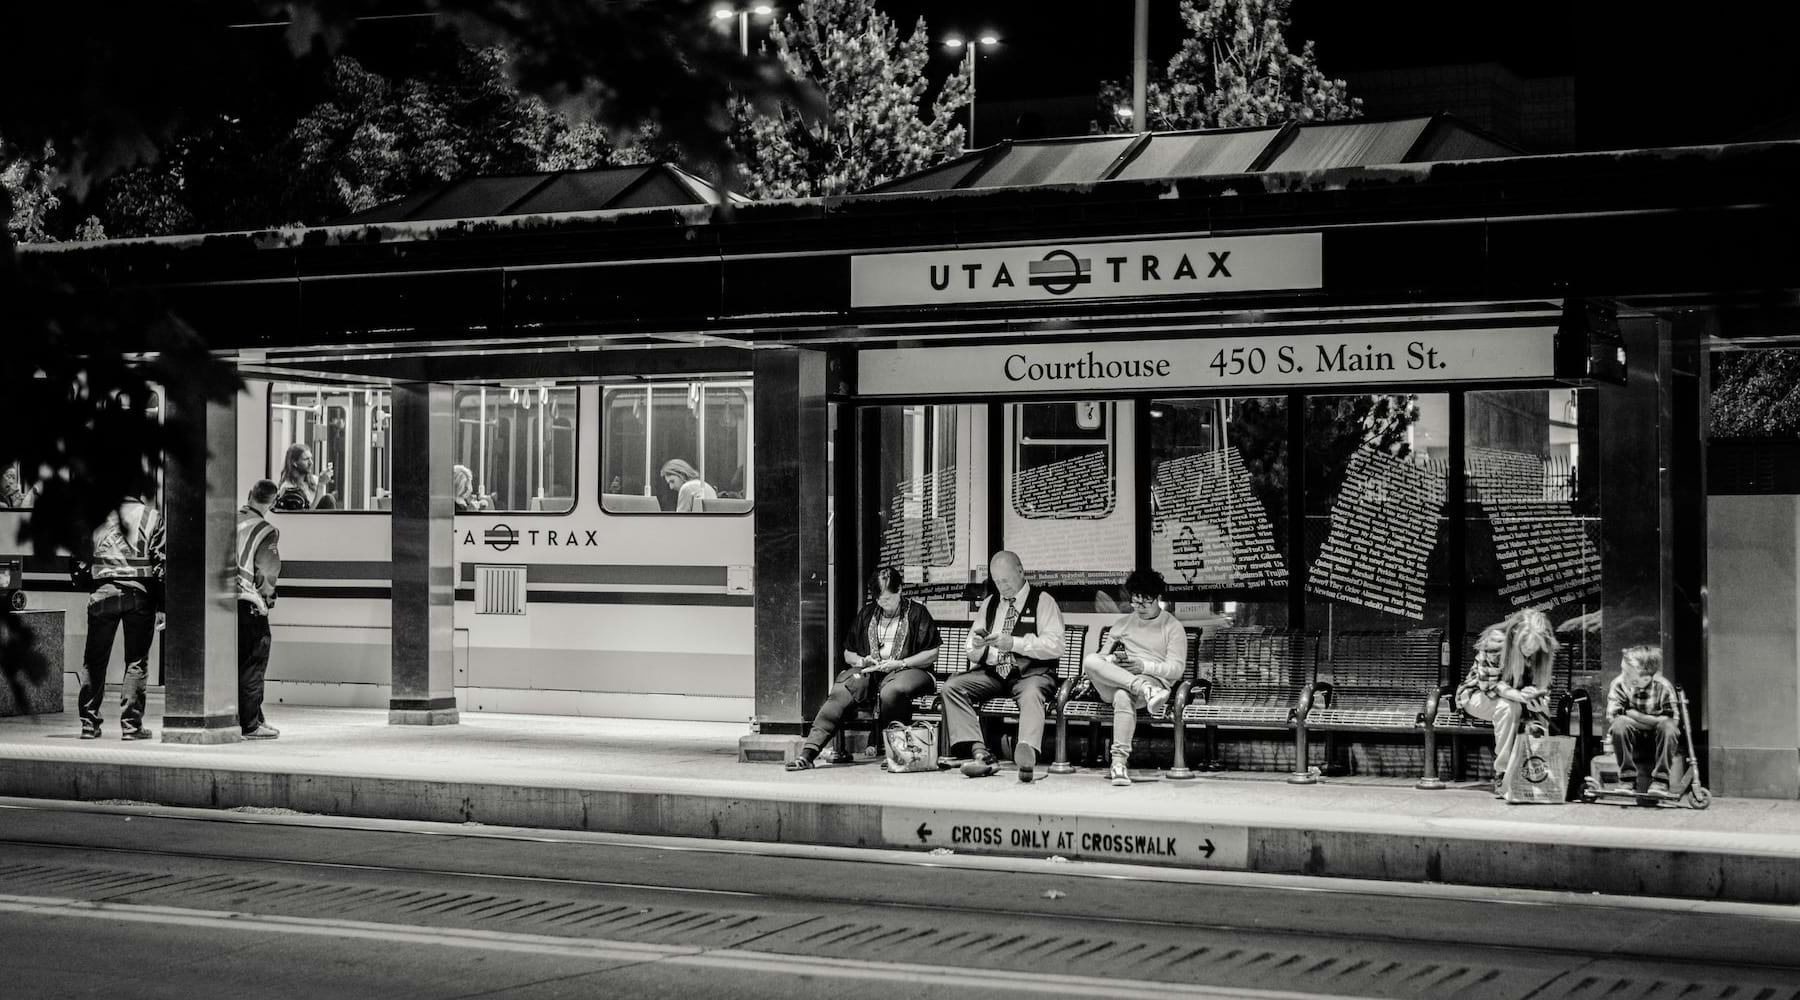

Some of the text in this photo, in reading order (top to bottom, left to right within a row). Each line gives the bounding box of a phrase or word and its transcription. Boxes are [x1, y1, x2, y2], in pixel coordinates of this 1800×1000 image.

[930, 250, 1233, 291] UTA TRAX
[1004, 341, 1447, 382] Courthouse 450 S. Main St.
[528, 530, 598, 546] TRAX
[951, 825, 1177, 856] CROSS ONLY AT CROSSWALK
